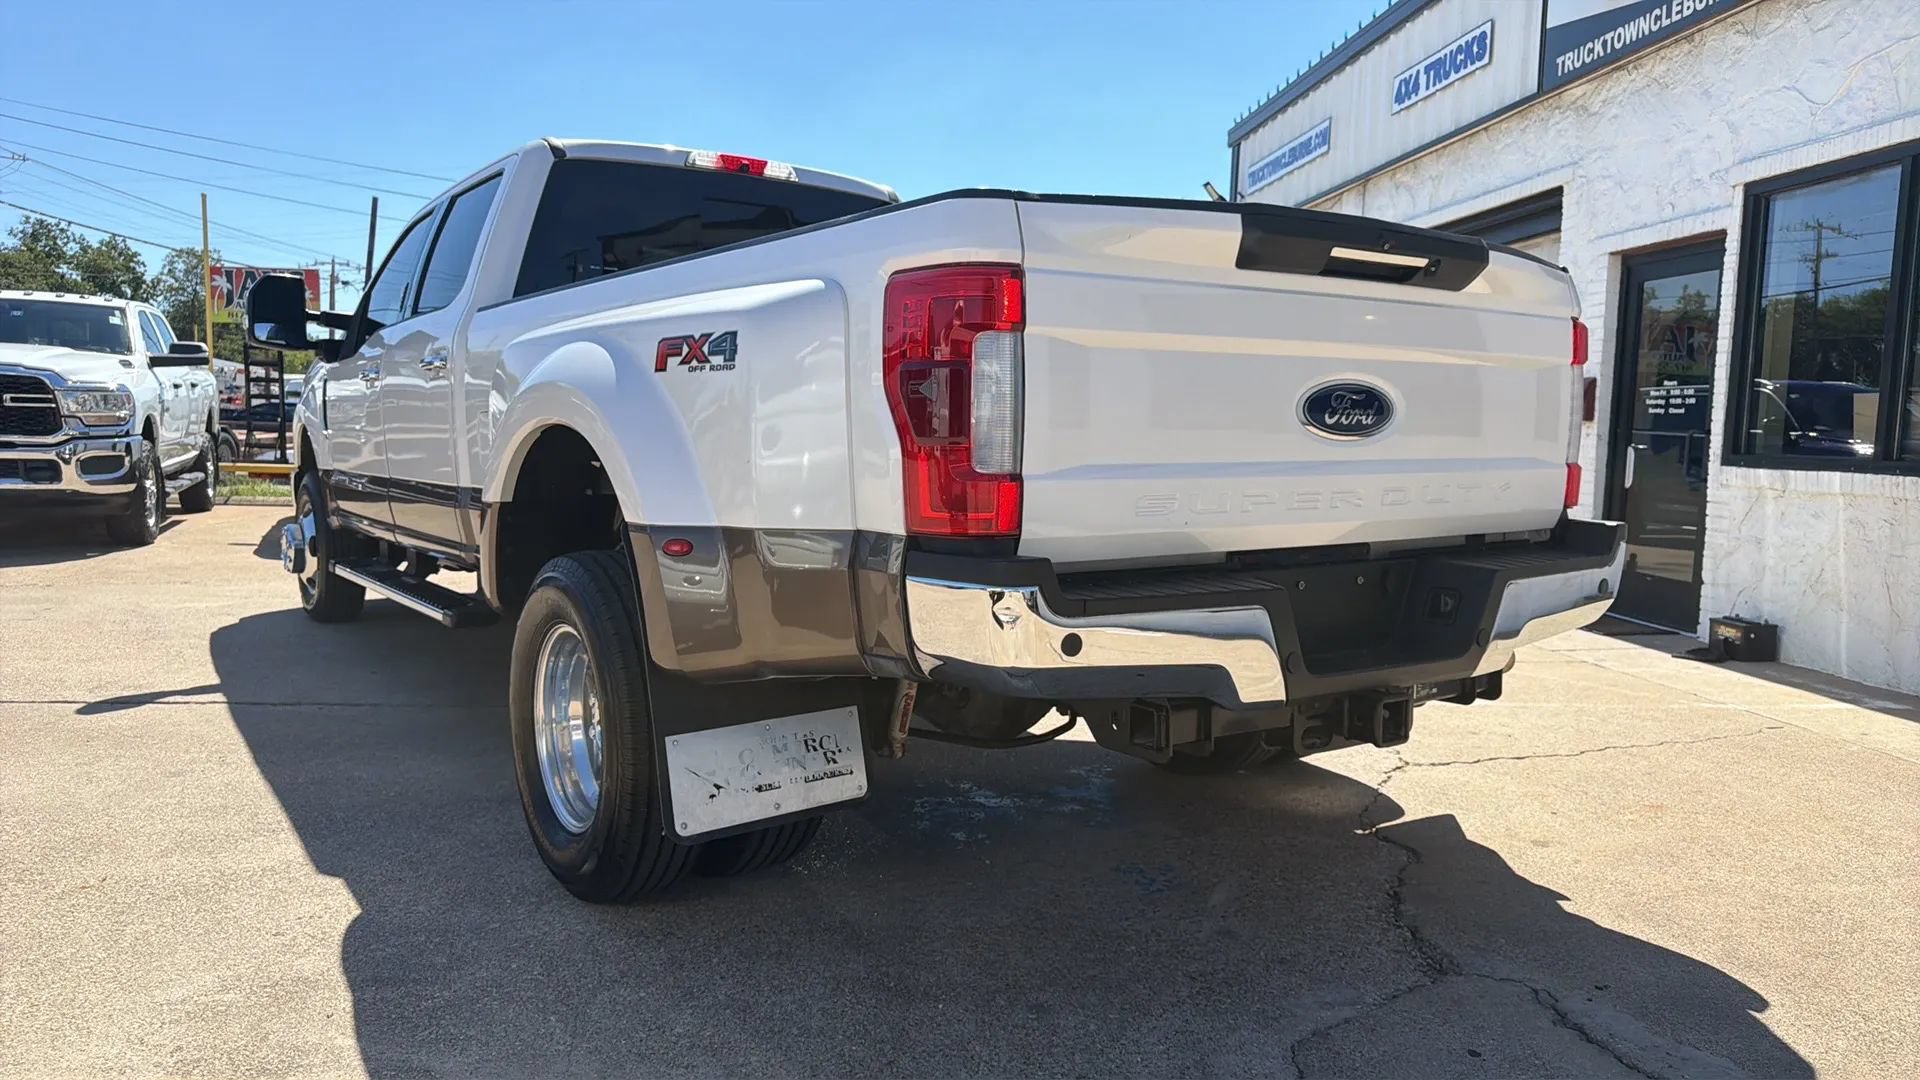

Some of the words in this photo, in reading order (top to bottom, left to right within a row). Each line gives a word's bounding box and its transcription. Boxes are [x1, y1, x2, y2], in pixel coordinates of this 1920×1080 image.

[1556, 0, 1720, 77] TRUCKTOWNCLEB
[1394, 69, 1420, 105] 4X4
[1424, 30, 1488, 90] TRUCKS
[655, 330, 738, 373] FX4
[688, 365, 706, 373] OFF
[709, 363, 736, 372] ROAD
[1325, 391, 1379, 425] Ford
[1136, 489, 1363, 517] SUPER
[1381, 481, 1512, 507] DUTY
